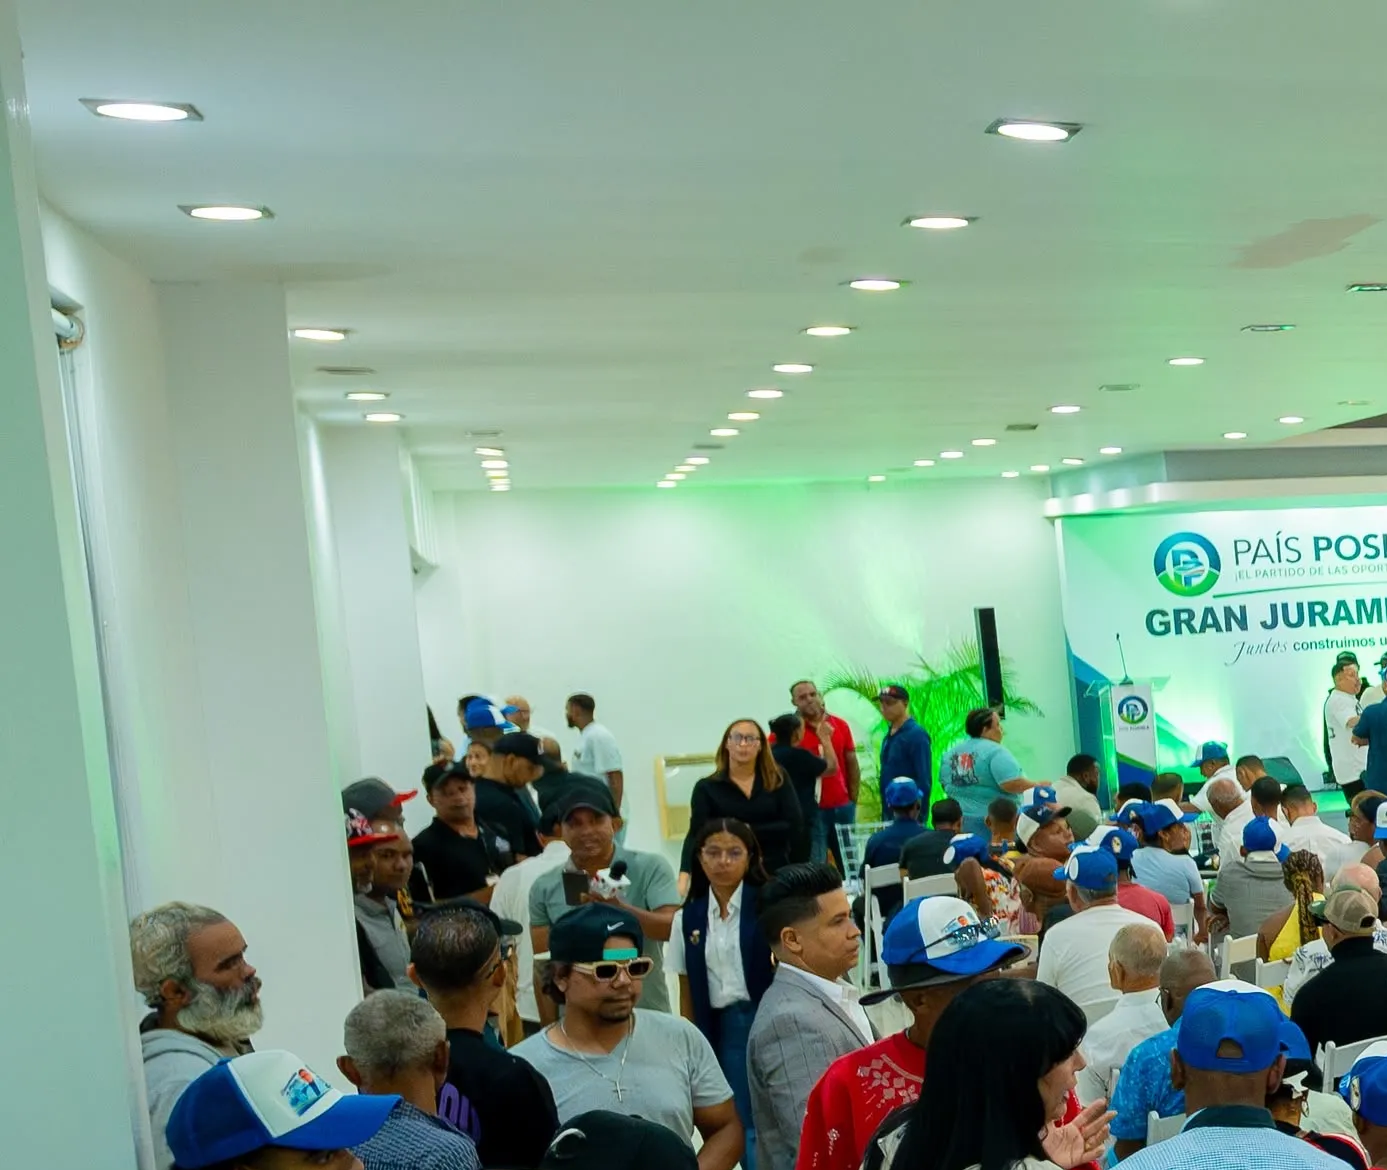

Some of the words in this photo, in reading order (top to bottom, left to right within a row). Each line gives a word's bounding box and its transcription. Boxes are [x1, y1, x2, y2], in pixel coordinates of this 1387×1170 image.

[1233, 531, 1302, 566] PAÍS
[1255, 567, 1306, 579] PARTIDO
[1309, 565, 1324, 577] DE
[1327, 564, 1349, 576] LAS
[1145, 603, 1249, 636] GRAN
[1224, 636, 1289, 667] Juntos
[1293, 635, 1376, 652] construimos
